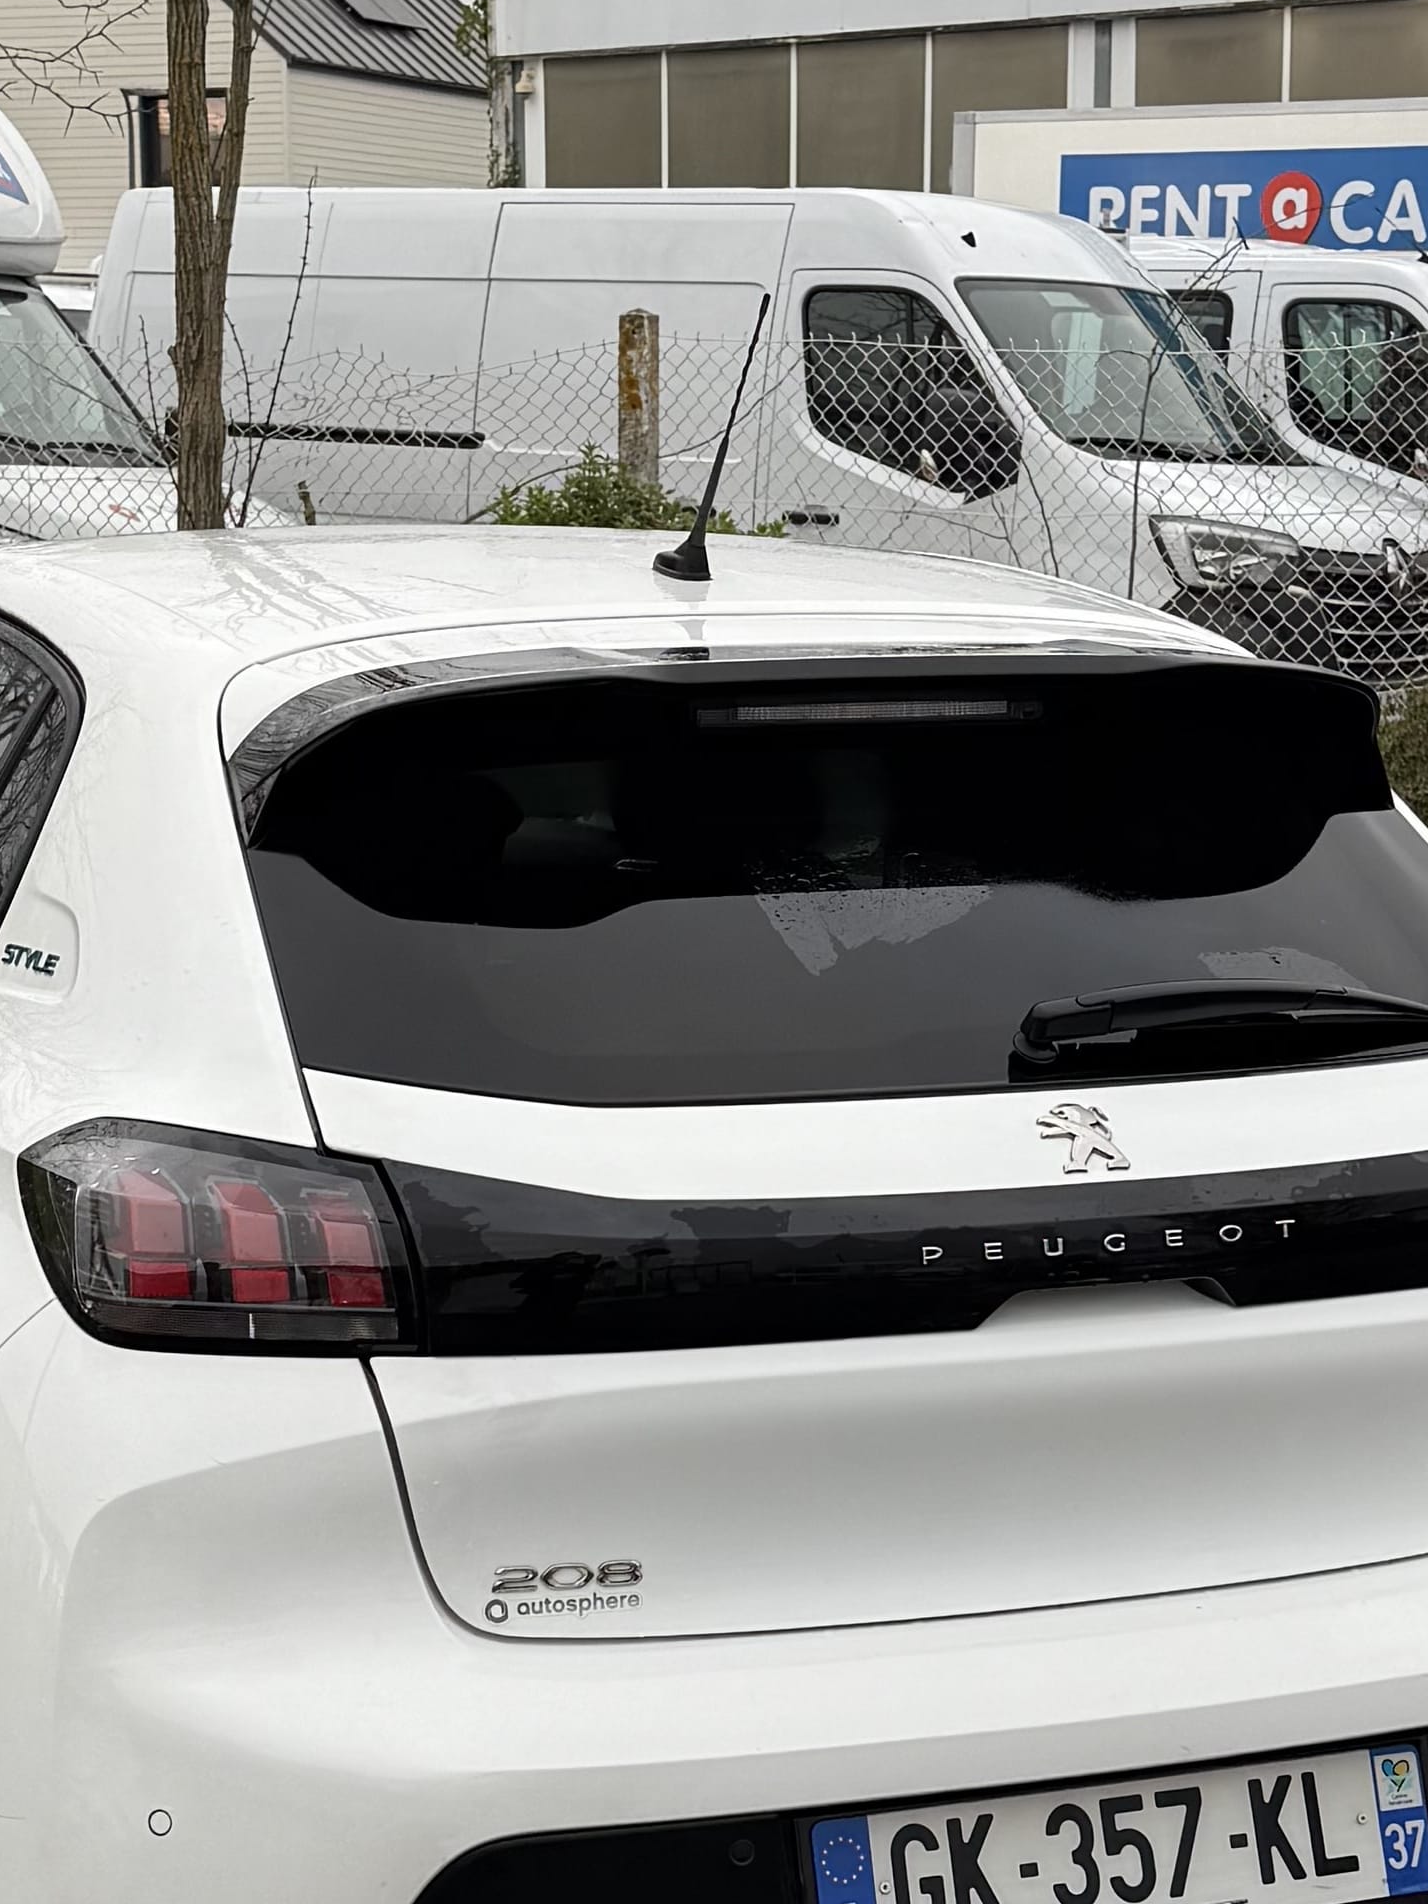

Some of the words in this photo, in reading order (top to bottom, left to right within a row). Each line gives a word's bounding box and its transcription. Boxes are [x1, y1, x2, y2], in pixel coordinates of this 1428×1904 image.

[1088, 183, 1252, 240] RENT
[1272, 187, 1308, 230] a
[1, 944, 60, 977] STYLE
[921, 1218, 1296, 1265] PEUGEOT
[492, 1559, 643, 1594] 208
[517, 1592, 640, 1616] autosphere
[1385, 1819, 1425, 1870] 37
